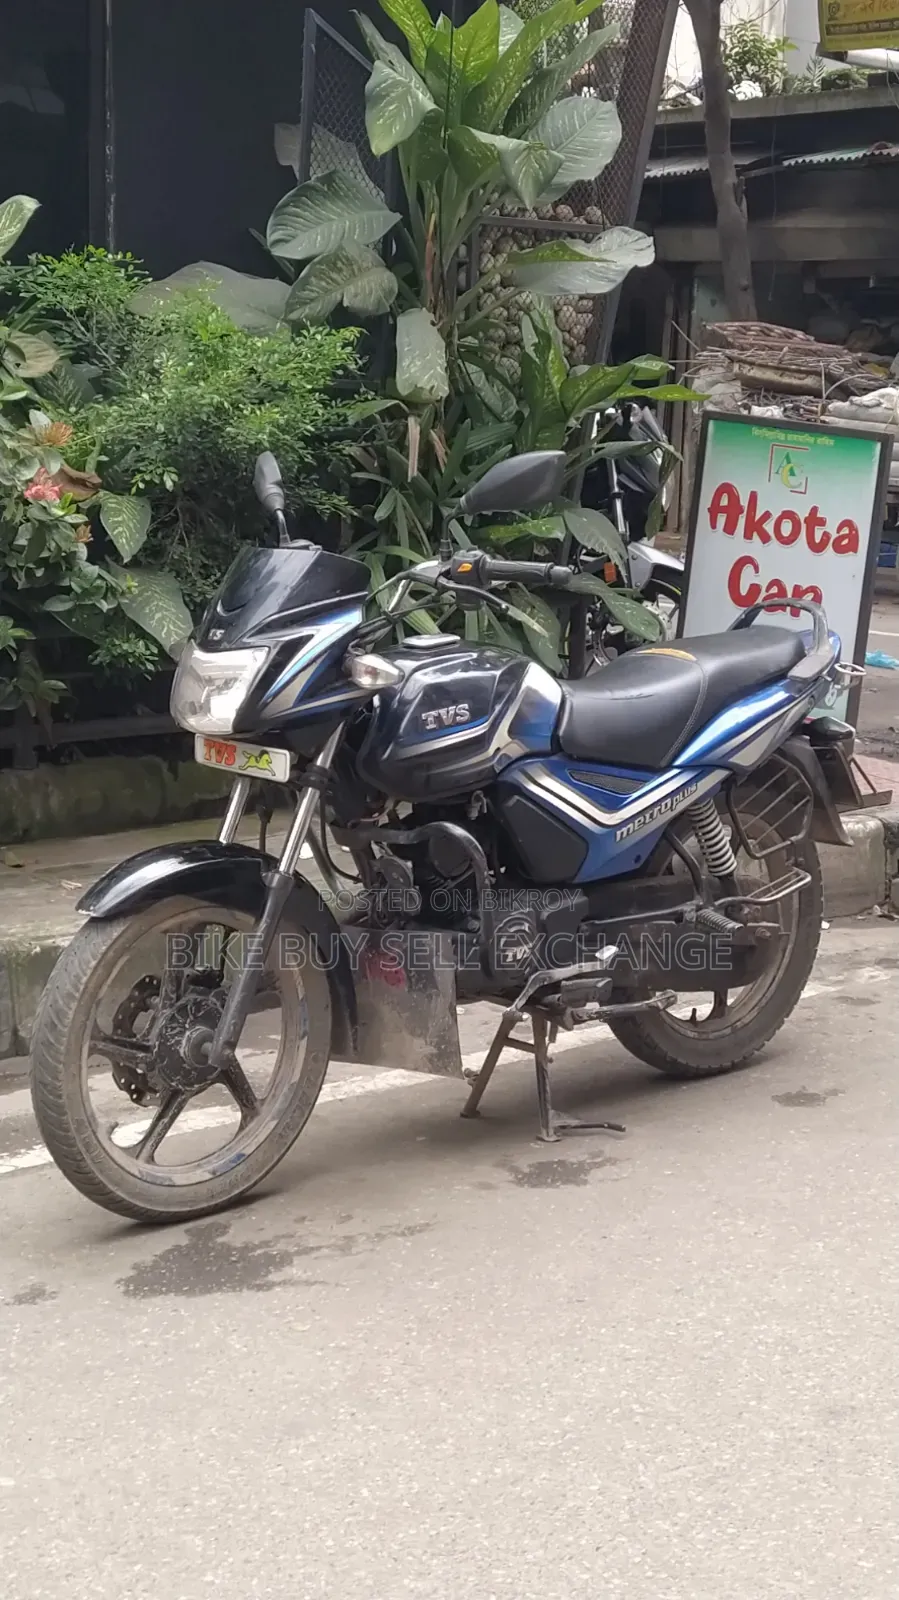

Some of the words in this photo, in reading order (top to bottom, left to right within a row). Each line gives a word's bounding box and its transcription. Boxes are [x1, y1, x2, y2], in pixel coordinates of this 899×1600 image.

[707, 481, 860, 554] Akota
[421, 703, 470, 730] TVS
[203, 738, 237, 766] TVS
